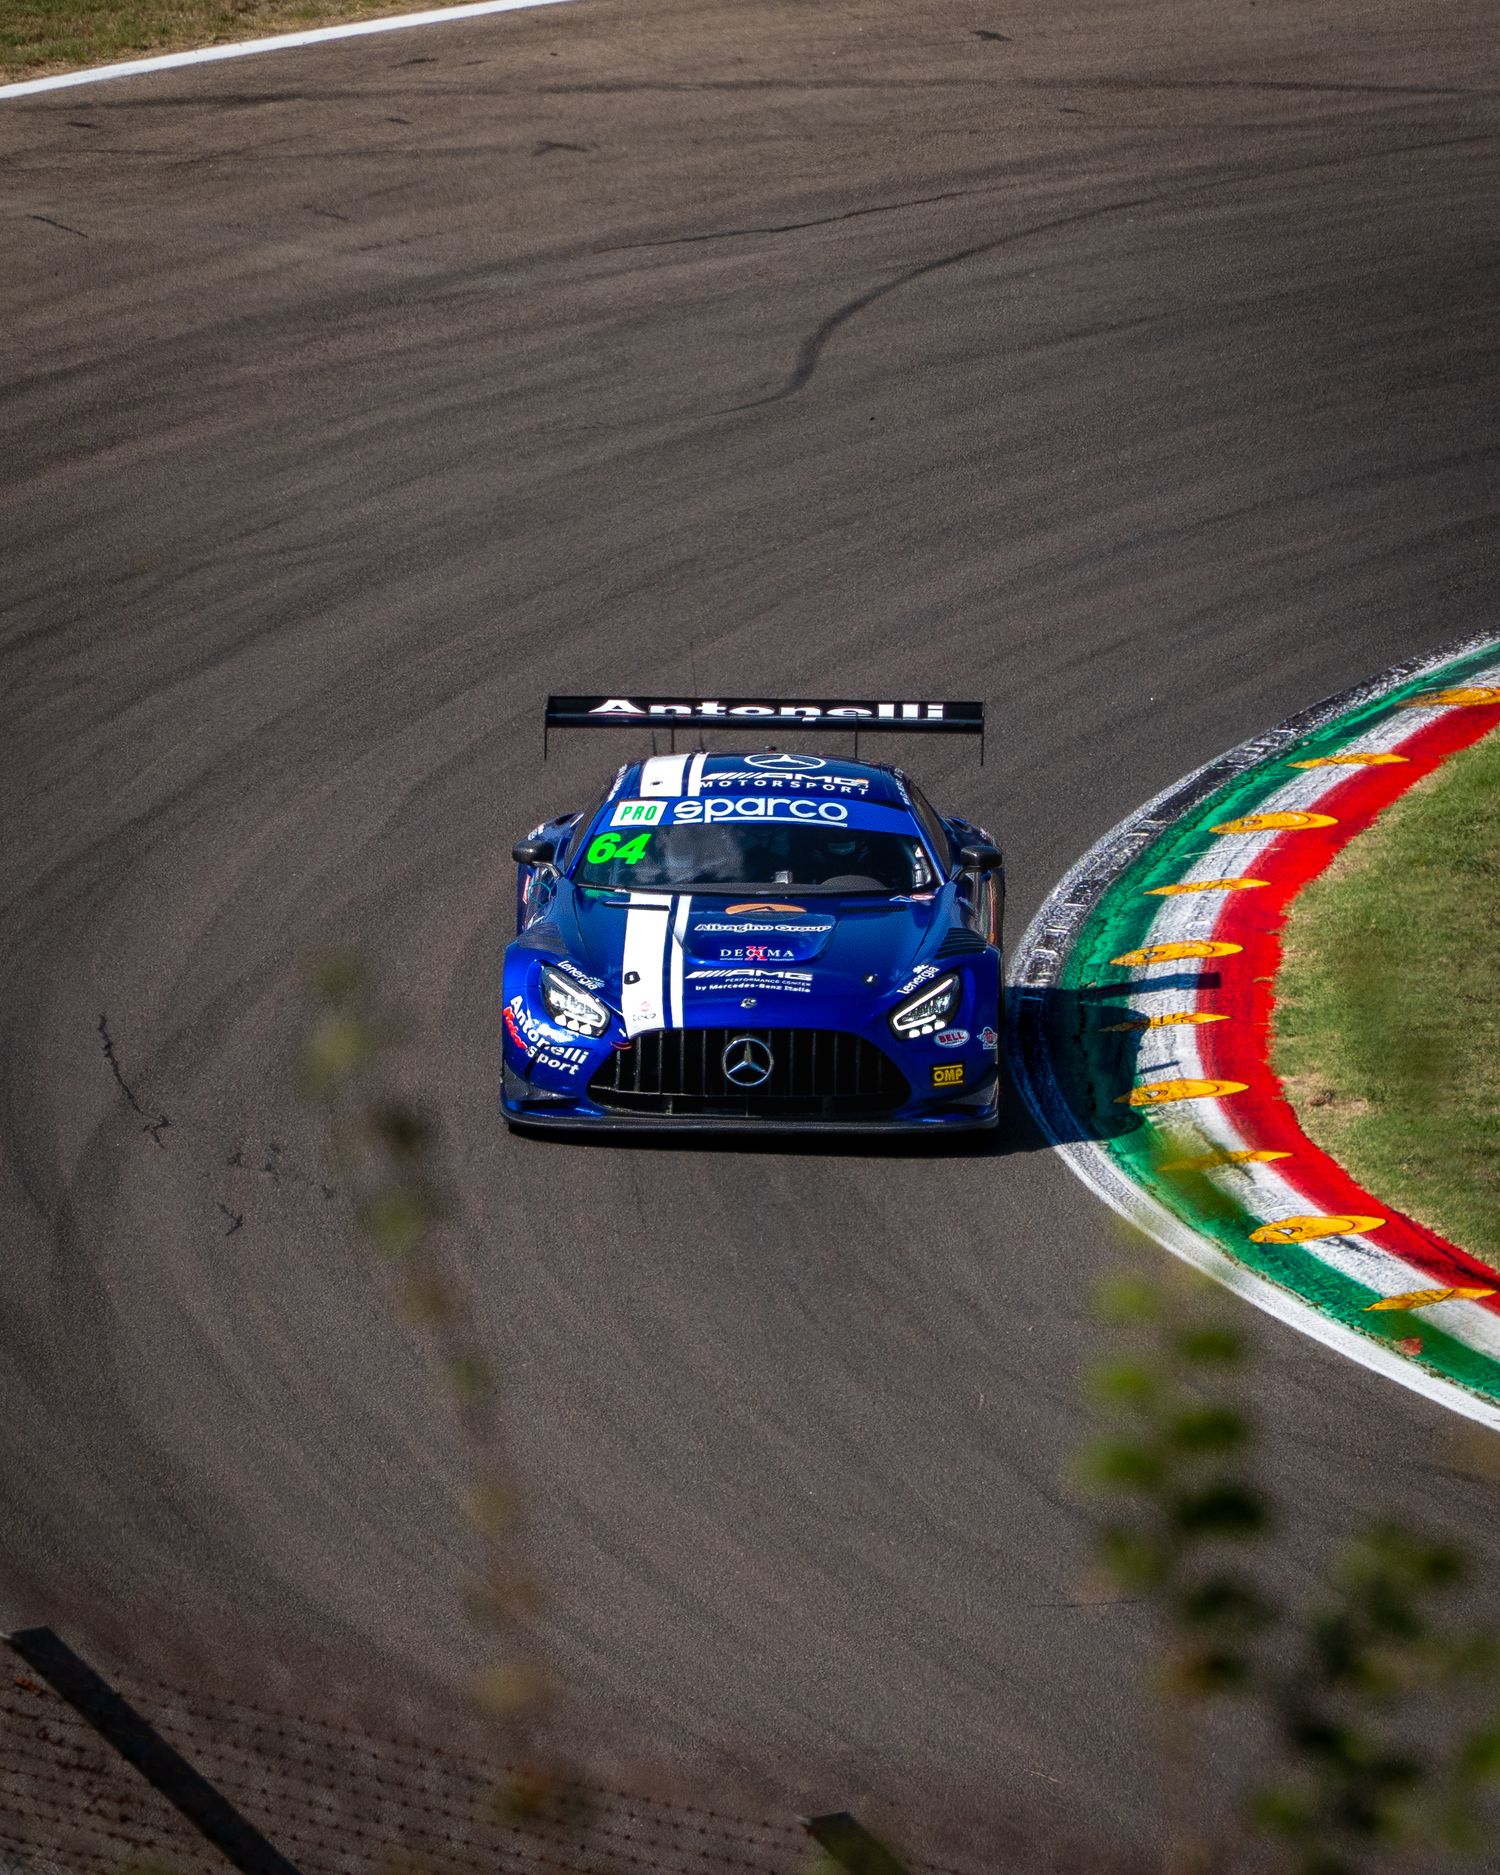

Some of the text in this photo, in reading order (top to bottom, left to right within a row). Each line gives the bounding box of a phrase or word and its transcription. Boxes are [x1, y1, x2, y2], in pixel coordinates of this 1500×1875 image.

[589, 699, 944, 720] Antonelli
[753, 772, 869, 787] AMG
[700, 780, 868, 795] MOTORSPORT
[620, 806, 657, 820] PRO
[674, 798, 848, 824] sparco
[587, 832, 652, 865] 64
[727, 969, 813, 981] AMG
[709, 983, 781, 991] Mercedes-Benz
[510, 995, 589, 1064] Antonelli
[938, 1031, 965, 1043] BELL
[933, 1069, 963, 1082] OMP
